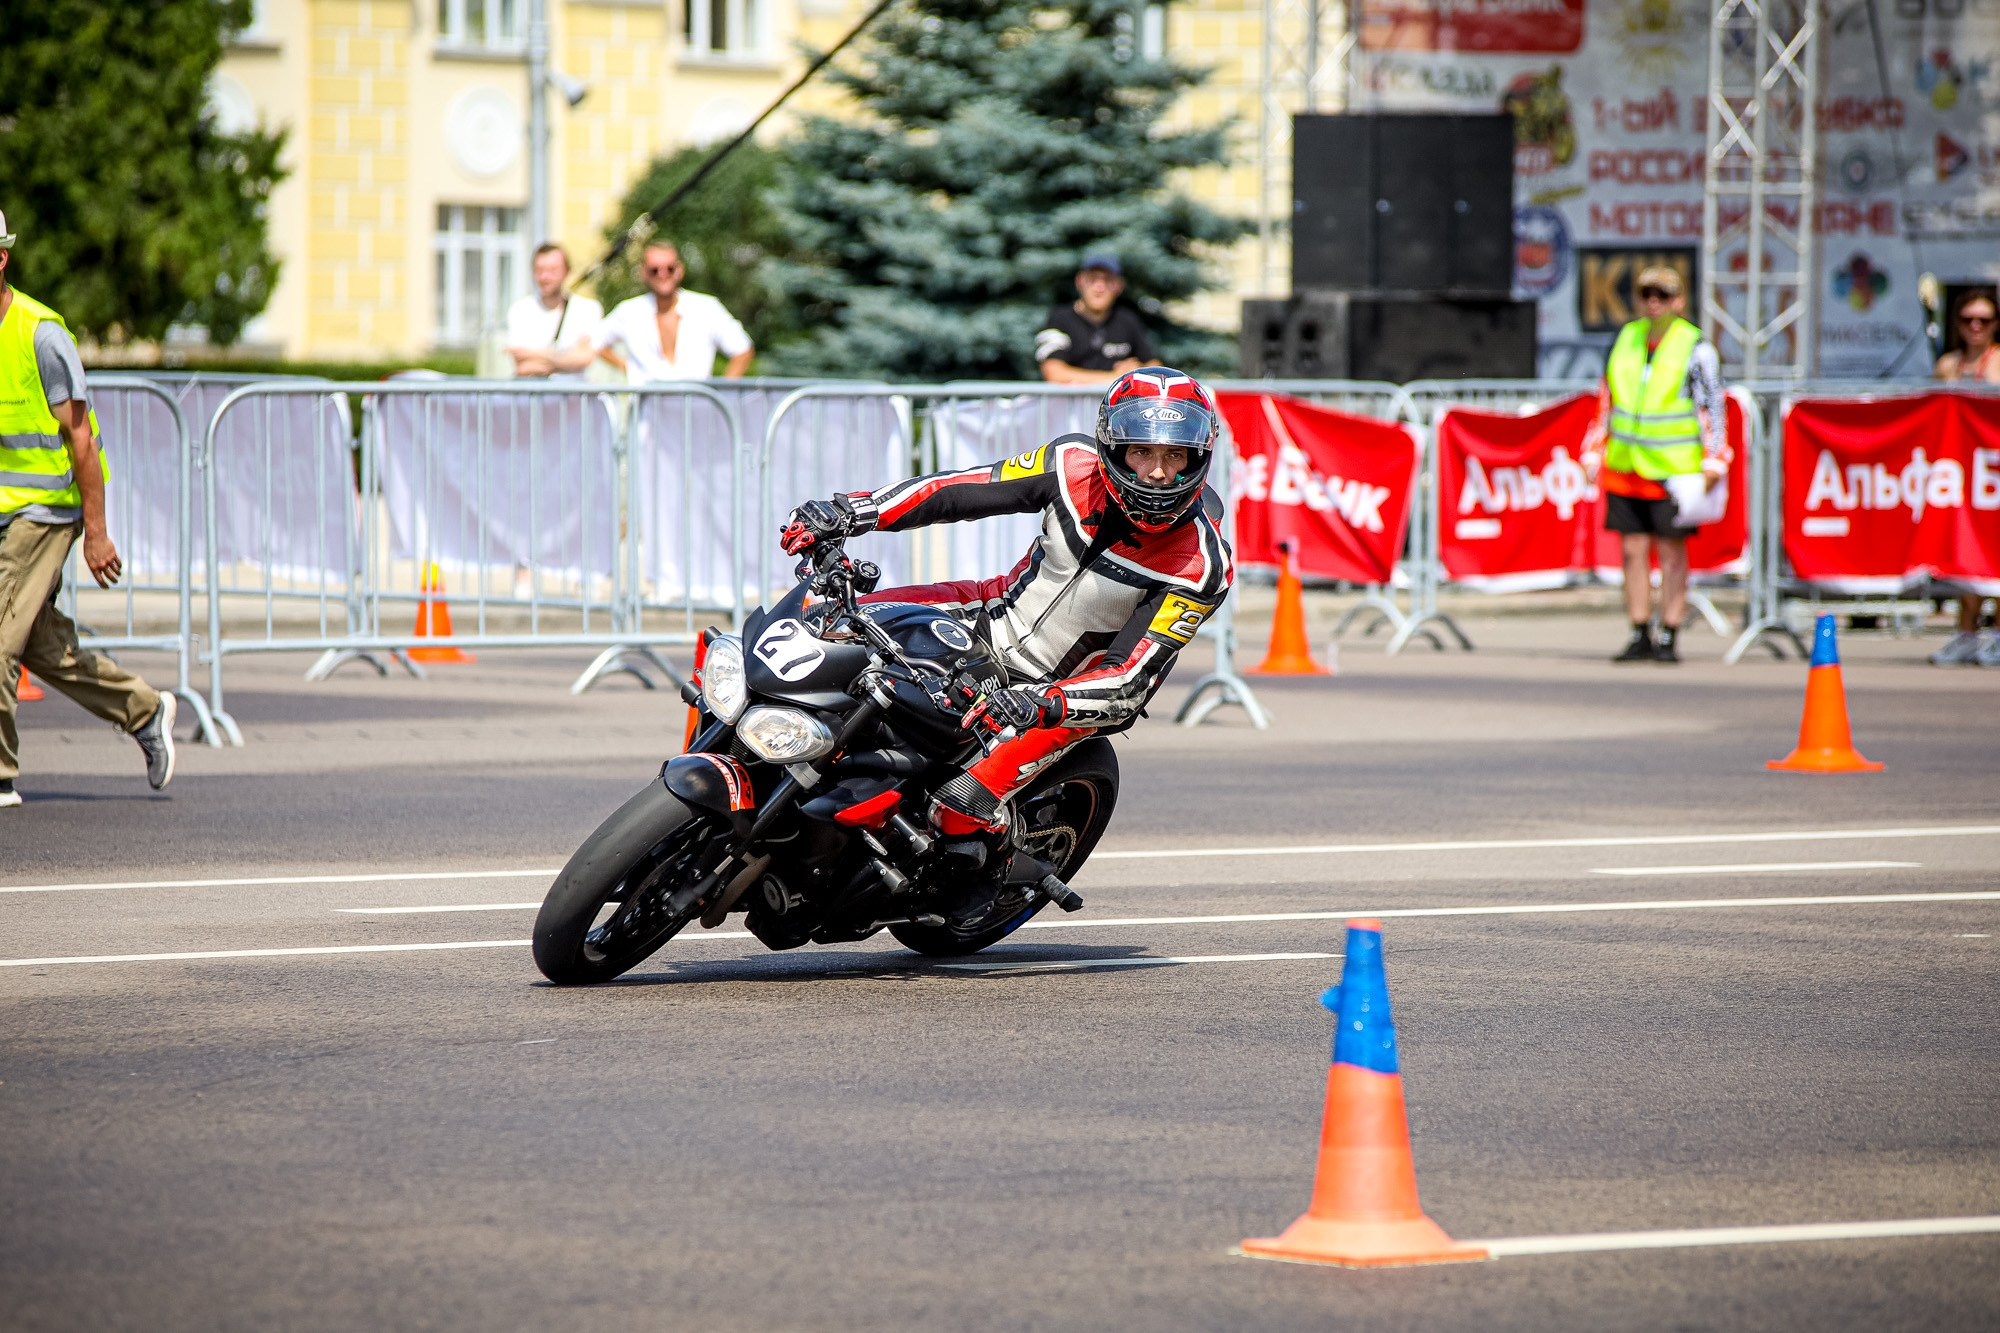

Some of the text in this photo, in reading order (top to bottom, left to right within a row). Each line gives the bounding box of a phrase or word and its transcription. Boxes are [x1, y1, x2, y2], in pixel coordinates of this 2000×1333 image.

[1588, 149, 1731, 185] РОССИ
[1802, 446, 1965, 524] Альфа
[1168, 609, 1205, 638] 2
[757, 621, 822, 676] 27
